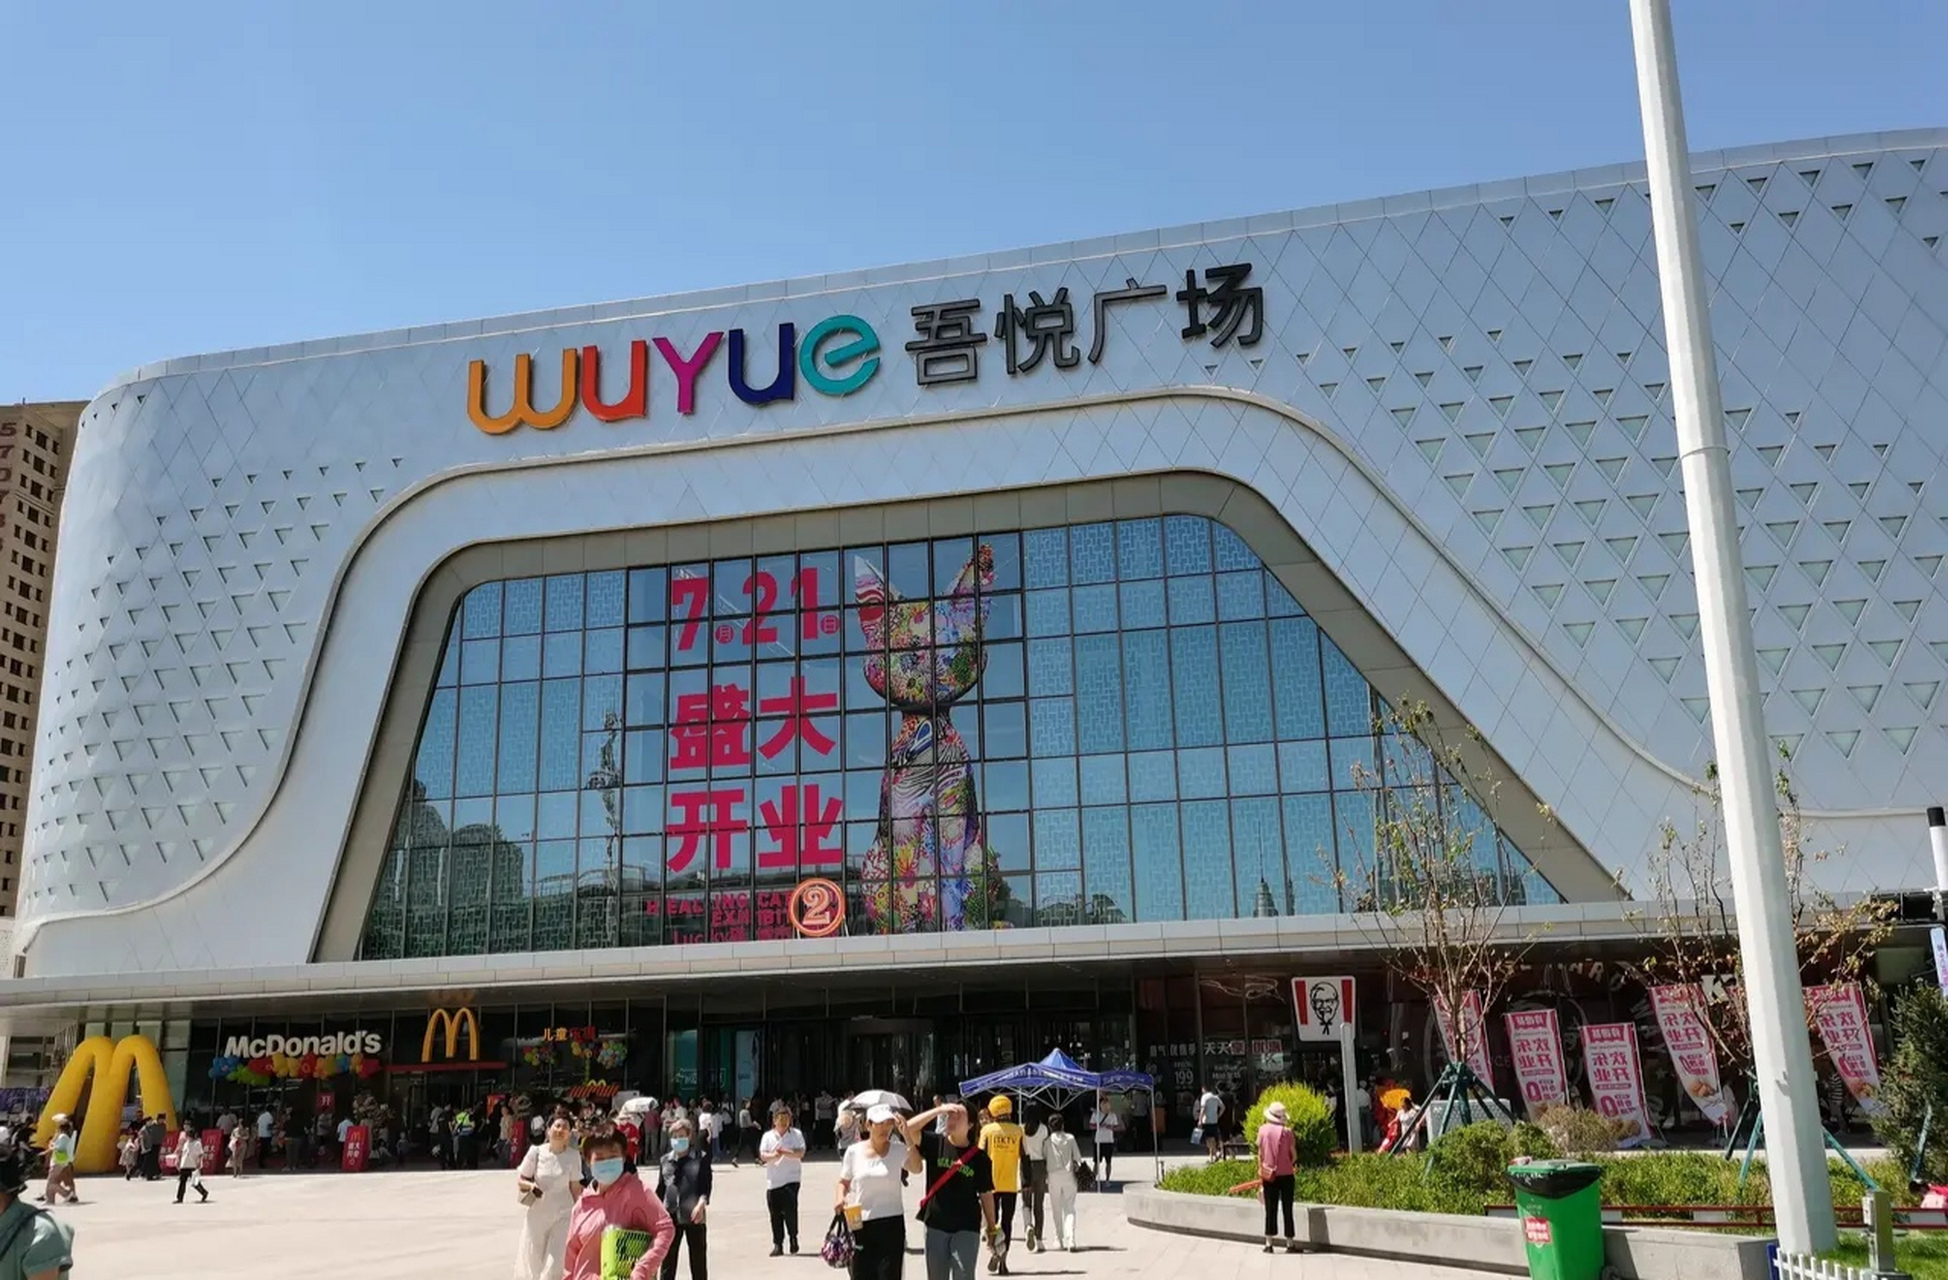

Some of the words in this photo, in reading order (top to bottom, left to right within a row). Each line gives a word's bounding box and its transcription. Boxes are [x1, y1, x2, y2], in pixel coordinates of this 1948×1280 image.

[905, 262, 1264, 387] 吾悦广场
[671, 566, 841, 651] 7月21日
[669, 675, 838, 770] 盛大
[666, 783, 844, 873] 开业
[224, 1030, 382, 1059] McDonald's
